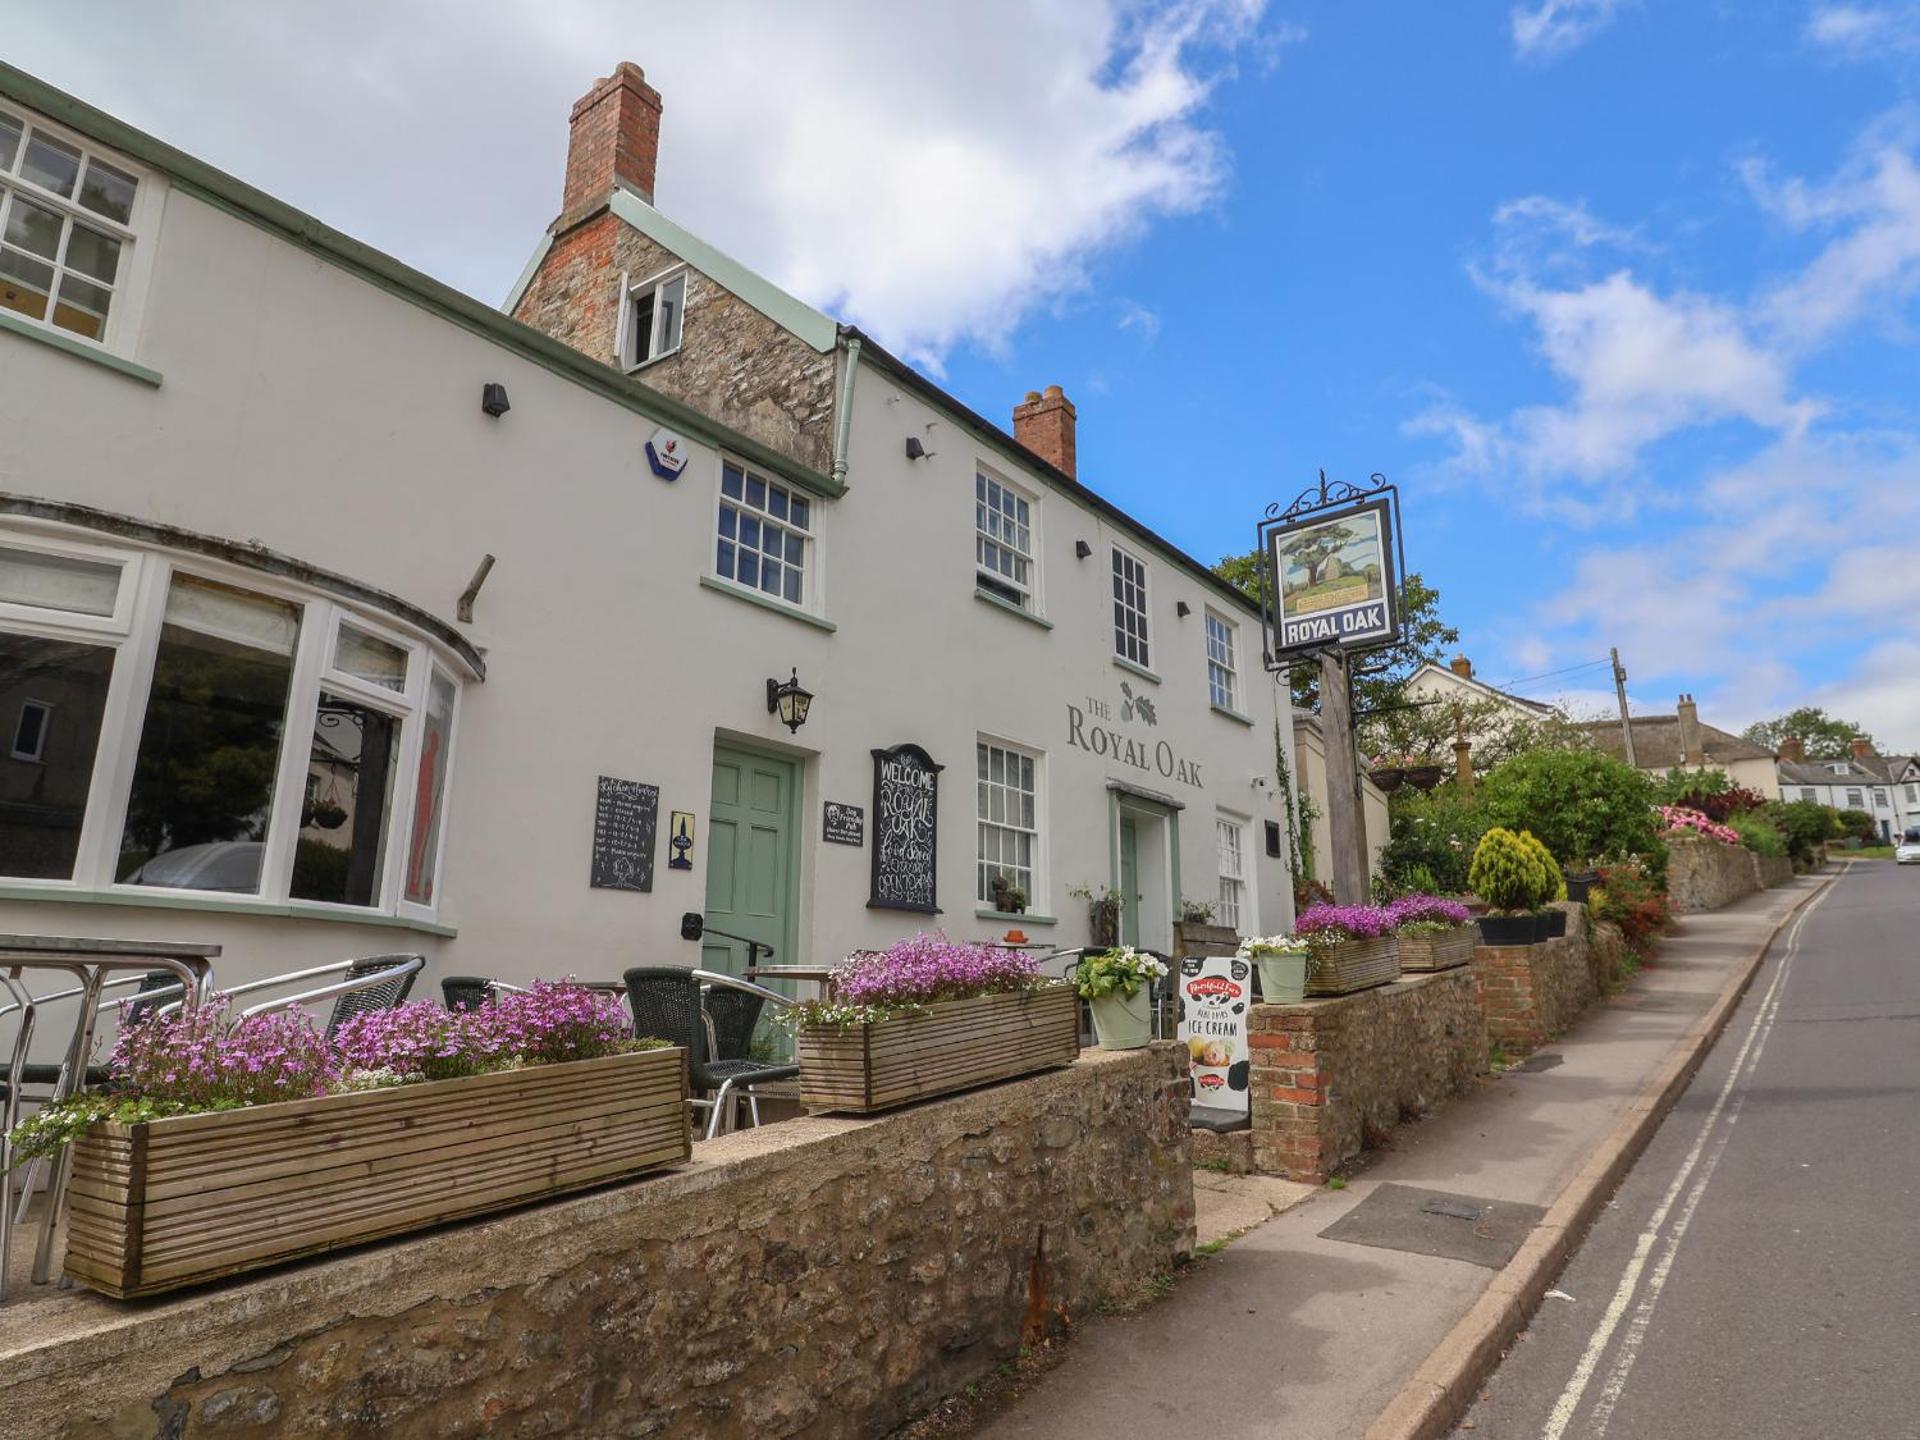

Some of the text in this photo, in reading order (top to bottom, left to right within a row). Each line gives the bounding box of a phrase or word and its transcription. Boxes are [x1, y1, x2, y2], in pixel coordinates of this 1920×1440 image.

[1288, 607, 1382, 644] ROYAL OAK
[1086, 696, 1112, 722] THE
[1066, 704, 1204, 789] ROYAL OAK
[881, 760, 935, 791] WELCOME
[881, 789, 934, 828] ROYAL
[1188, 1020, 1238, 1037] ICE CREAM
